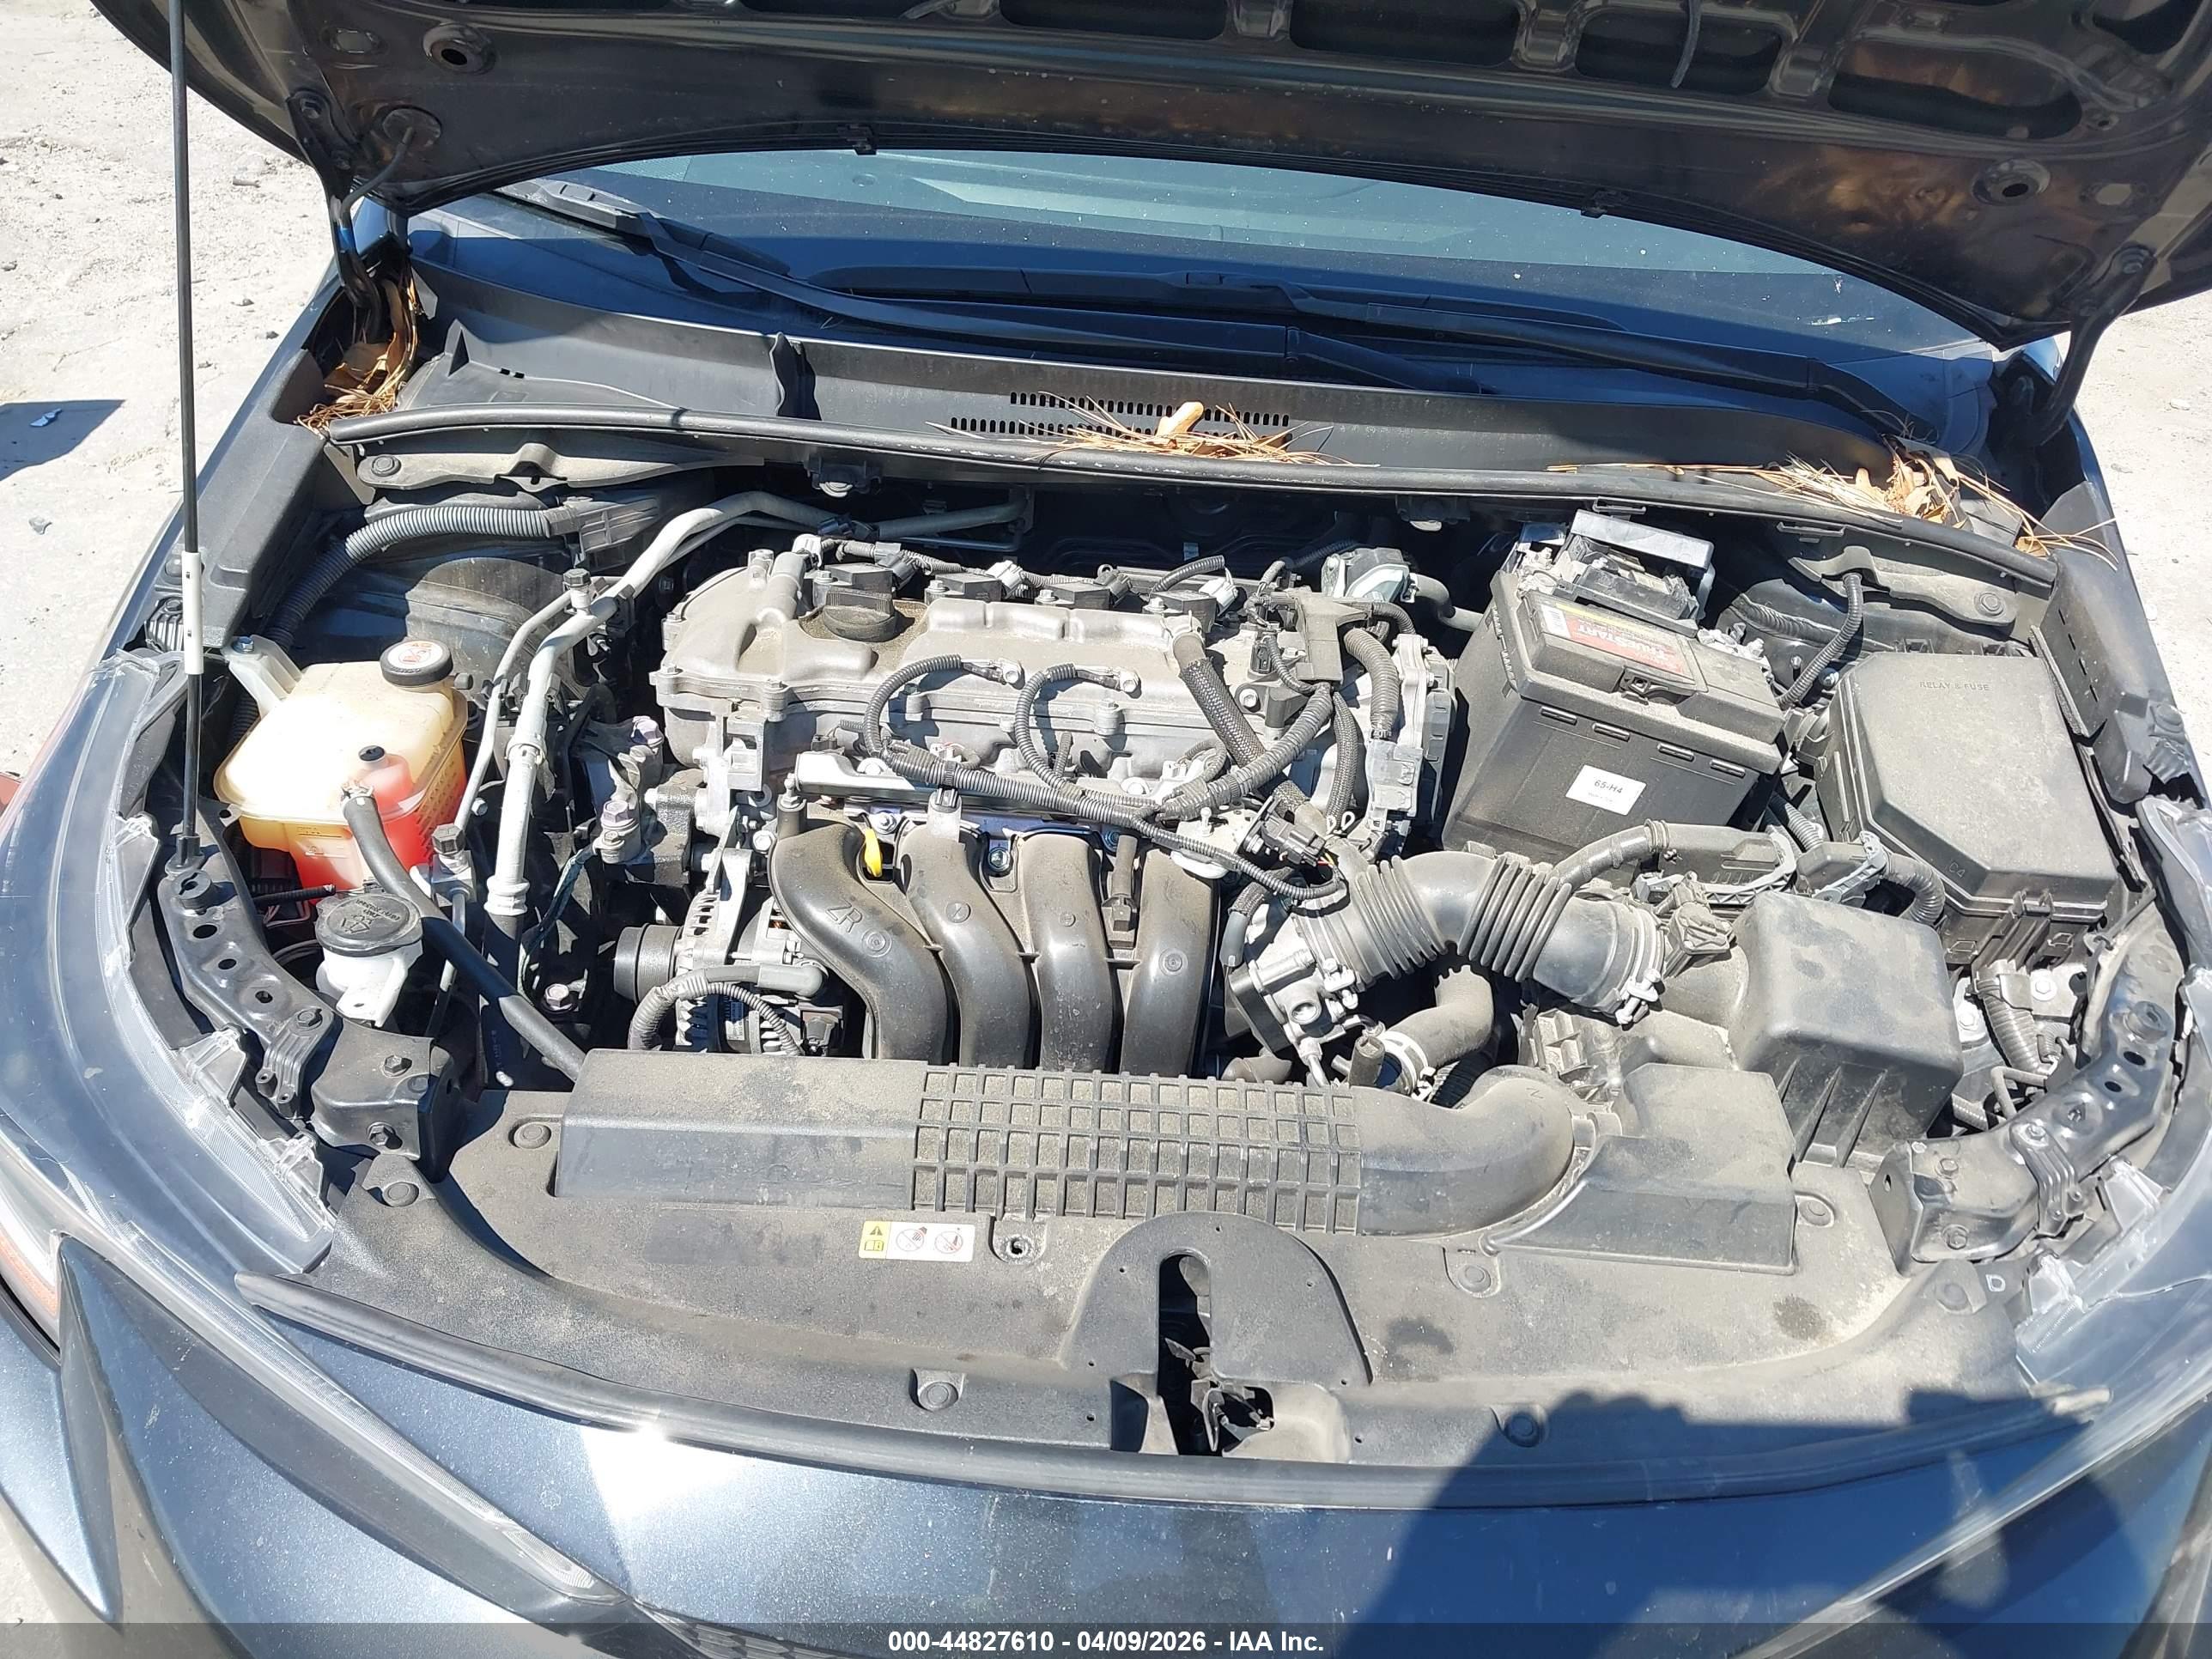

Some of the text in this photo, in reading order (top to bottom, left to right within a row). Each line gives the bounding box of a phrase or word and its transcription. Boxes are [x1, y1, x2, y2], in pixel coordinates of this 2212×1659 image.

[1577, 623, 1668, 661] TRUESTART
[1919, 681, 1951, 690] RELAY
[1964, 683, 1990, 691] FUSE
[1594, 780, 1624, 794] 65-H4
[824, 898, 863, 933] ZR
